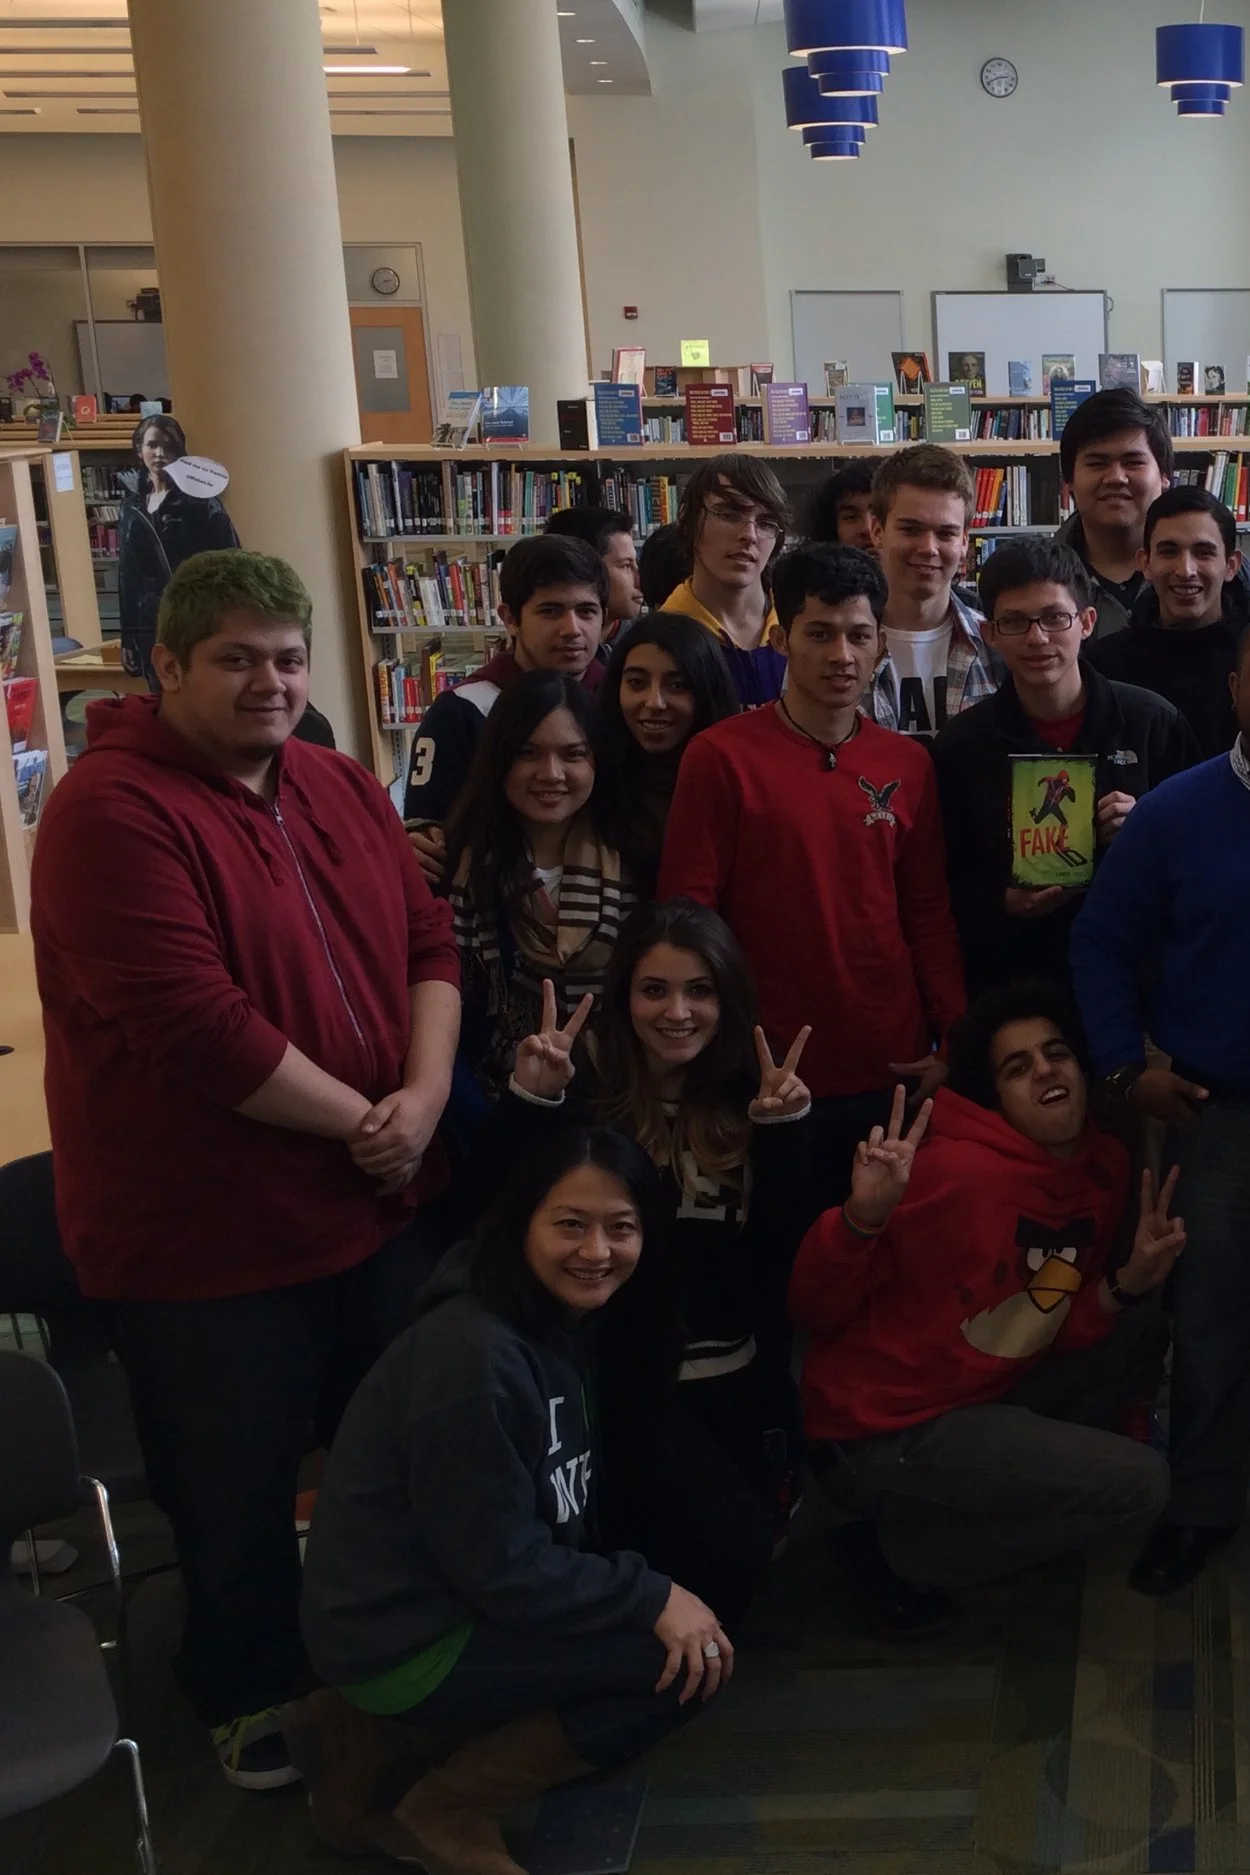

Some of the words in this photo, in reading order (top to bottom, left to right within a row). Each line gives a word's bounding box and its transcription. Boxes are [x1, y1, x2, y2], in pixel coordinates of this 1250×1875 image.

[410, 737, 437, 786] 3
[1020, 824, 1069, 858] FAKE
[547, 1396, 565, 1457] I
